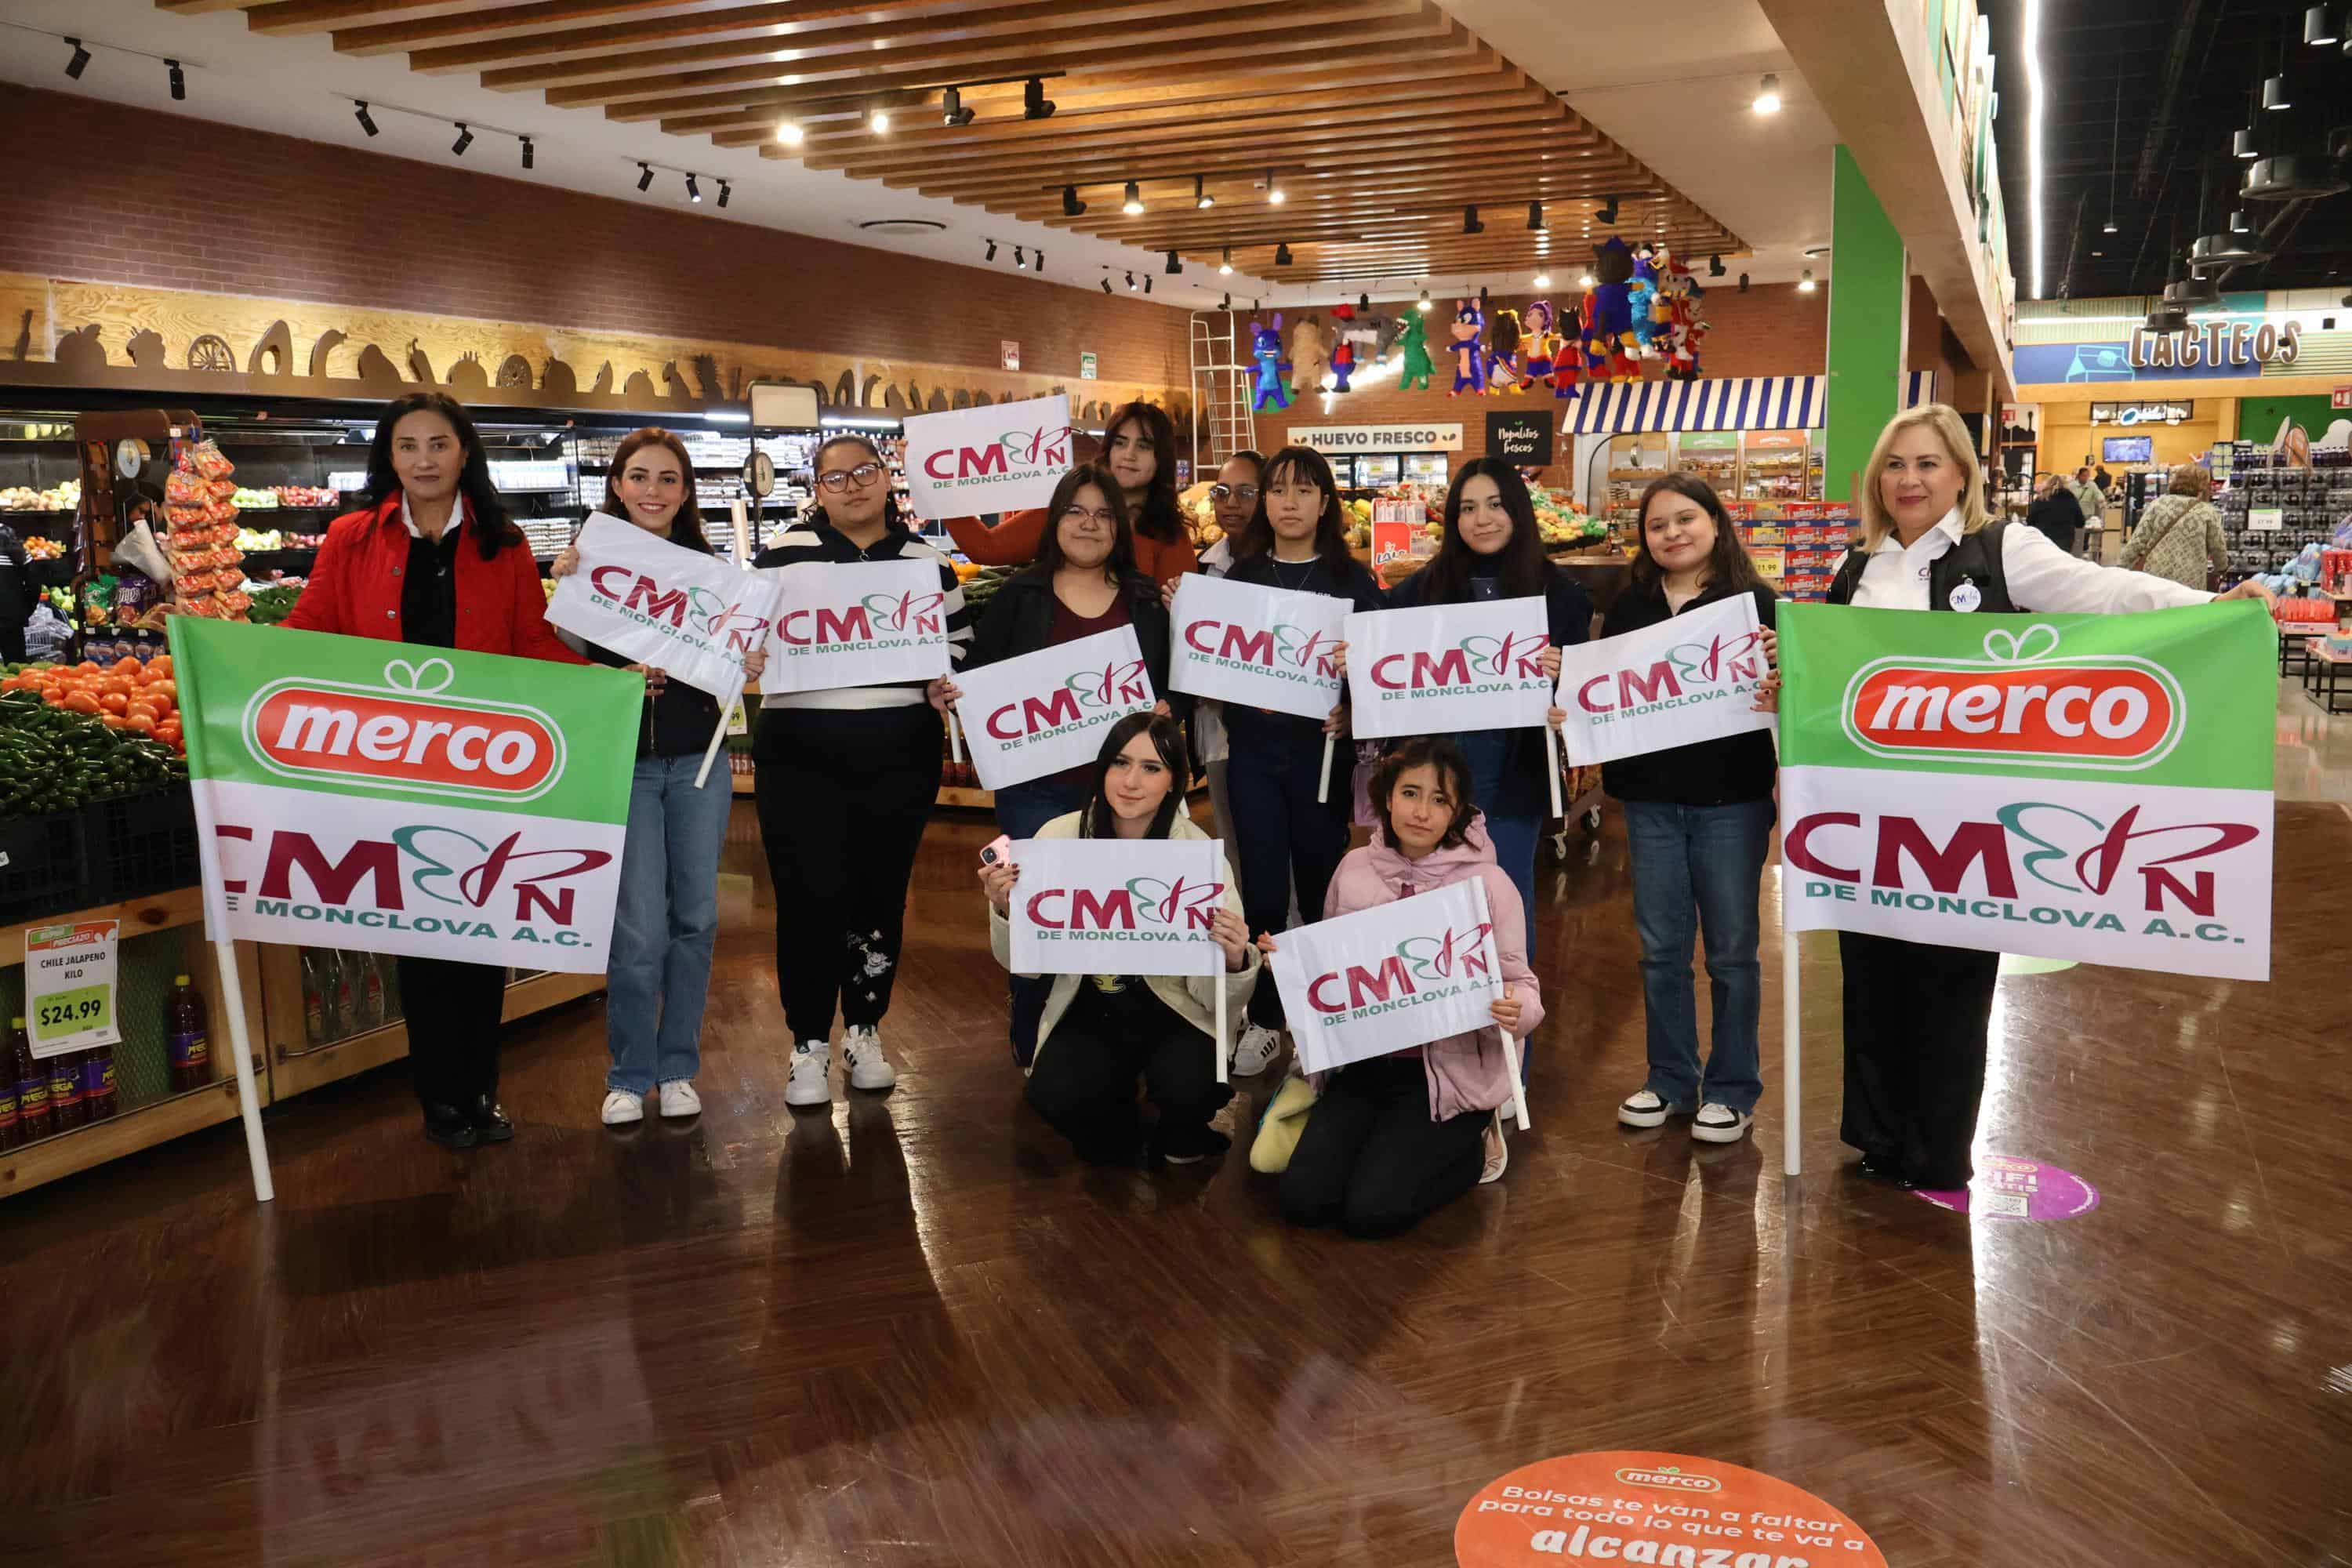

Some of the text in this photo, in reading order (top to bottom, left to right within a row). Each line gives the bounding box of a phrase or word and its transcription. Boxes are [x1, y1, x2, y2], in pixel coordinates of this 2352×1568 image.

[1312, 430, 1436, 445] HUEVO FRESCO
[1498, 426, 1539, 441] Nopalitos
[933, 480, 953, 489] DE
[957, 470, 1041, 487] MONCLOVA
[590, 593, 613, 610] DE
[619, 605, 715, 653] MONCLOVA
[788, 646, 810, 656] DE
[815, 637, 912, 654] MONCLOVA
[1189, 652, 1210, 663] DE
[1215, 657, 1308, 684] MONCLOVA
[1381, 691, 1405, 701] DE
[1411, 682, 1513, 699] MONCLOVA
[1591, 712, 1615, 725] DE
[1621, 689, 1728, 720] MONCLOVA
[1869, 684, 2149, 739] merco
[274, 704, 536, 776] merco
[1000, 739, 1023, 751] DE
[1028, 710, 1121, 743] MONCLOVA
[255, 898, 497, 938] MONCLOVA
[511, 927, 593, 947] A.C.
[1806, 881, 2245, 943] DE MONCLOVA A.C.
[1036, 931, 1063, 940] DE
[1069, 931, 1181, 941] MONCLOVA
[41, 956, 64, 968] CHILE
[64, 969, 83, 979] KILO
[41, 999, 101, 1027] $24.99
[1323, 1014, 1346, 1027] DE
[1352, 985, 1461, 1020] MONCLOVA
[1626, 1471, 1711, 1489] merco
[1478, 1500, 1864, 1552] para todo lo que te va a
[1501, 1486, 1844, 1533] Bolsas te van a faltar
[1530, 1524, 1809, 1568] alcanzar
